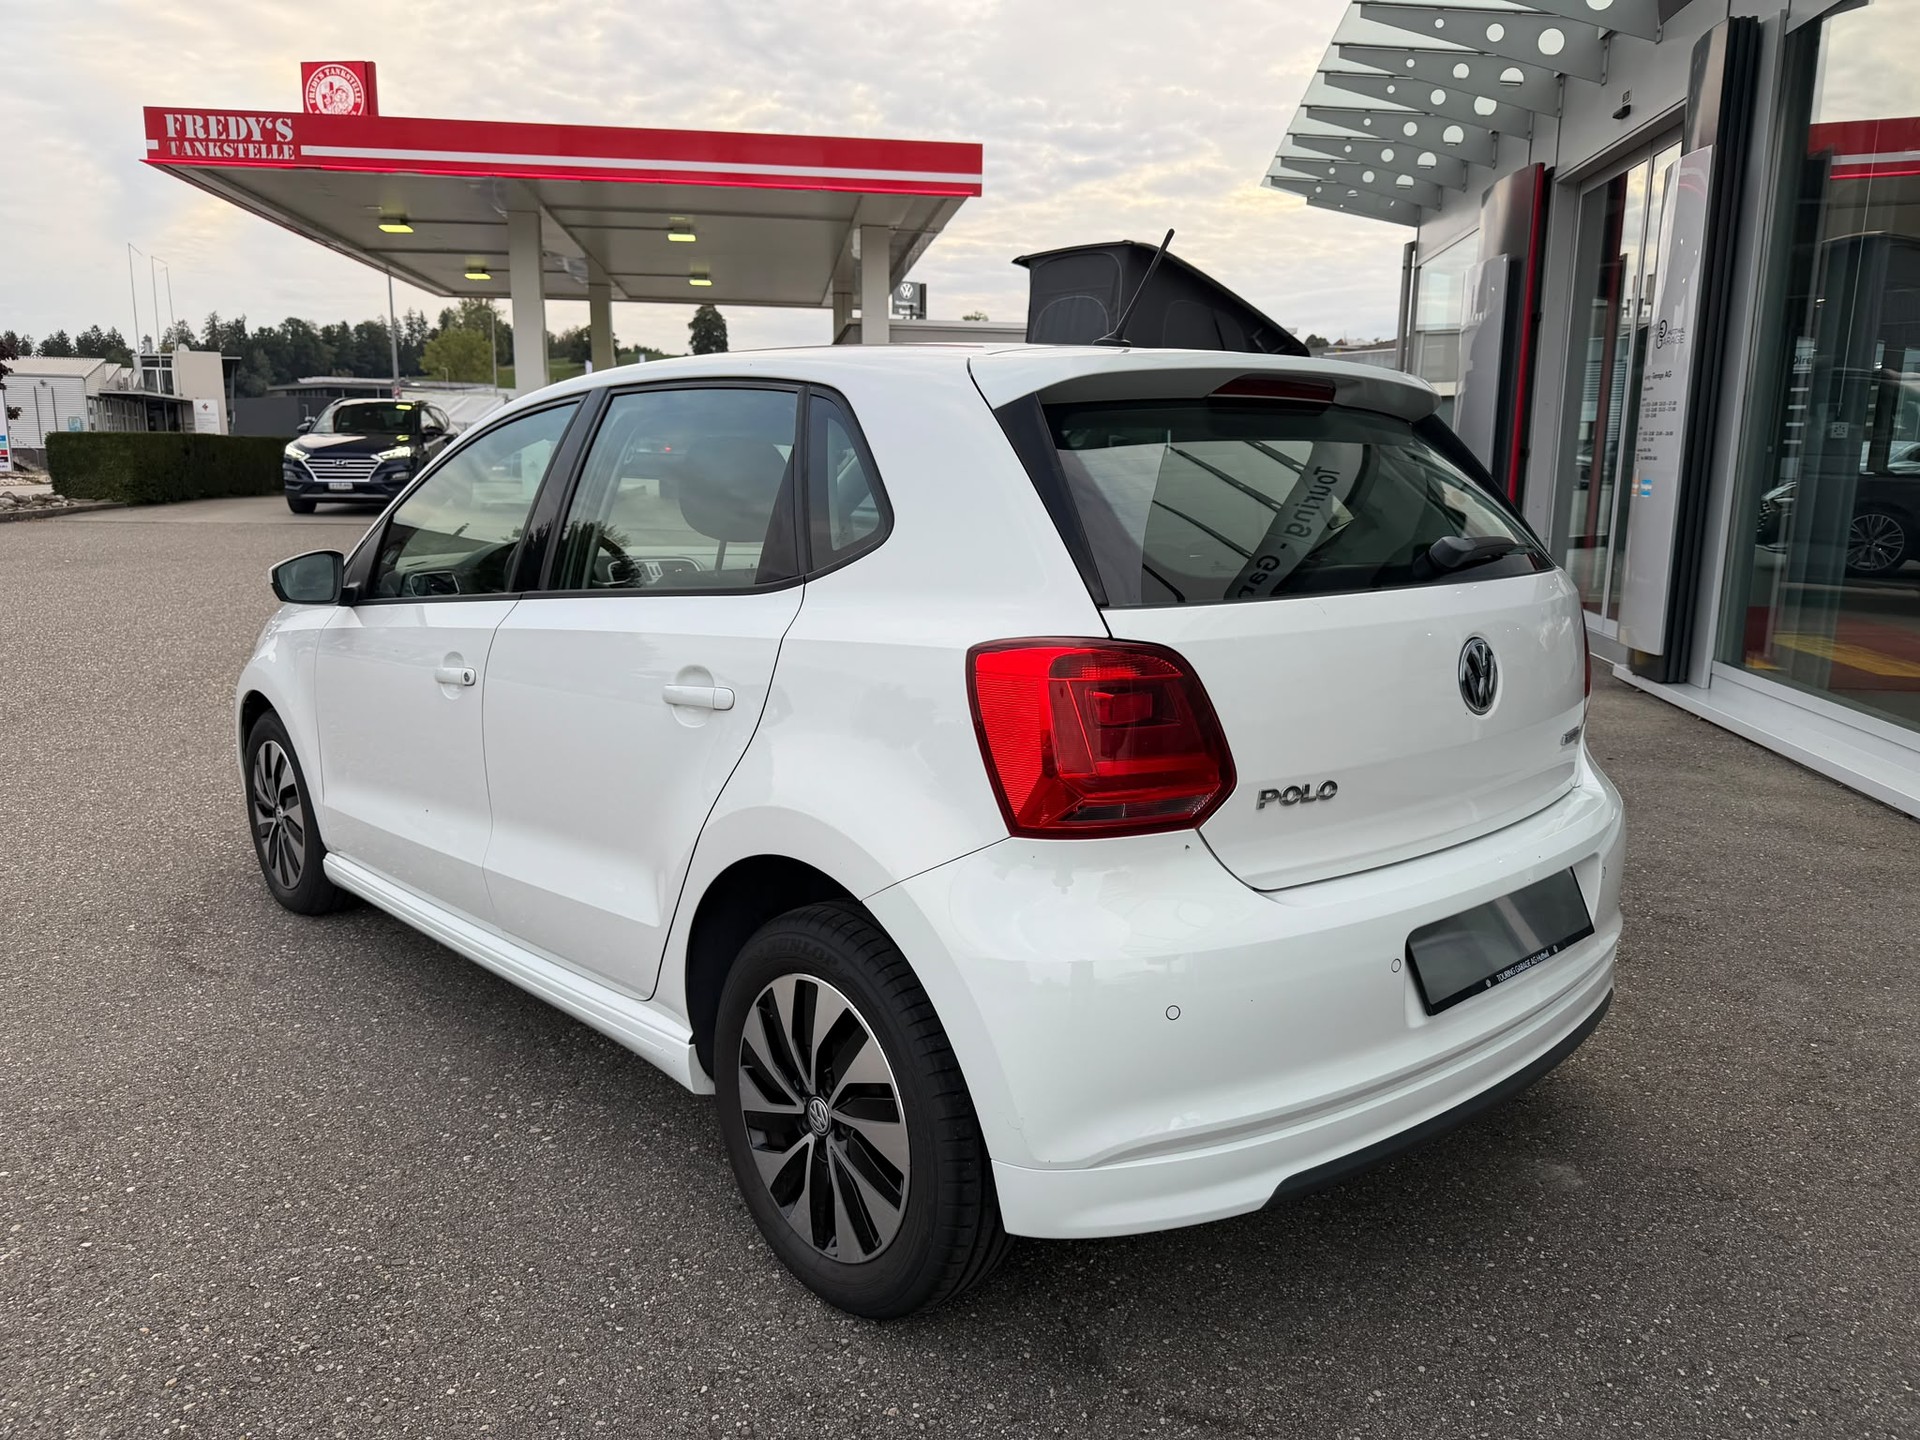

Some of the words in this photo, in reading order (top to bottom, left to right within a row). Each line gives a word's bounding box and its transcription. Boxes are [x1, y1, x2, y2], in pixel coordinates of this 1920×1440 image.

[323, 67, 362, 104] TANKSTELLE
[164, 113, 294, 142] FREDY'S
[166, 140, 295, 160] TANKSTELLE
[1256, 779, 1338, 810] POLO
[1496, 966, 1516, 982] TOURING
[1514, 958, 1531, 973] GARAGE
